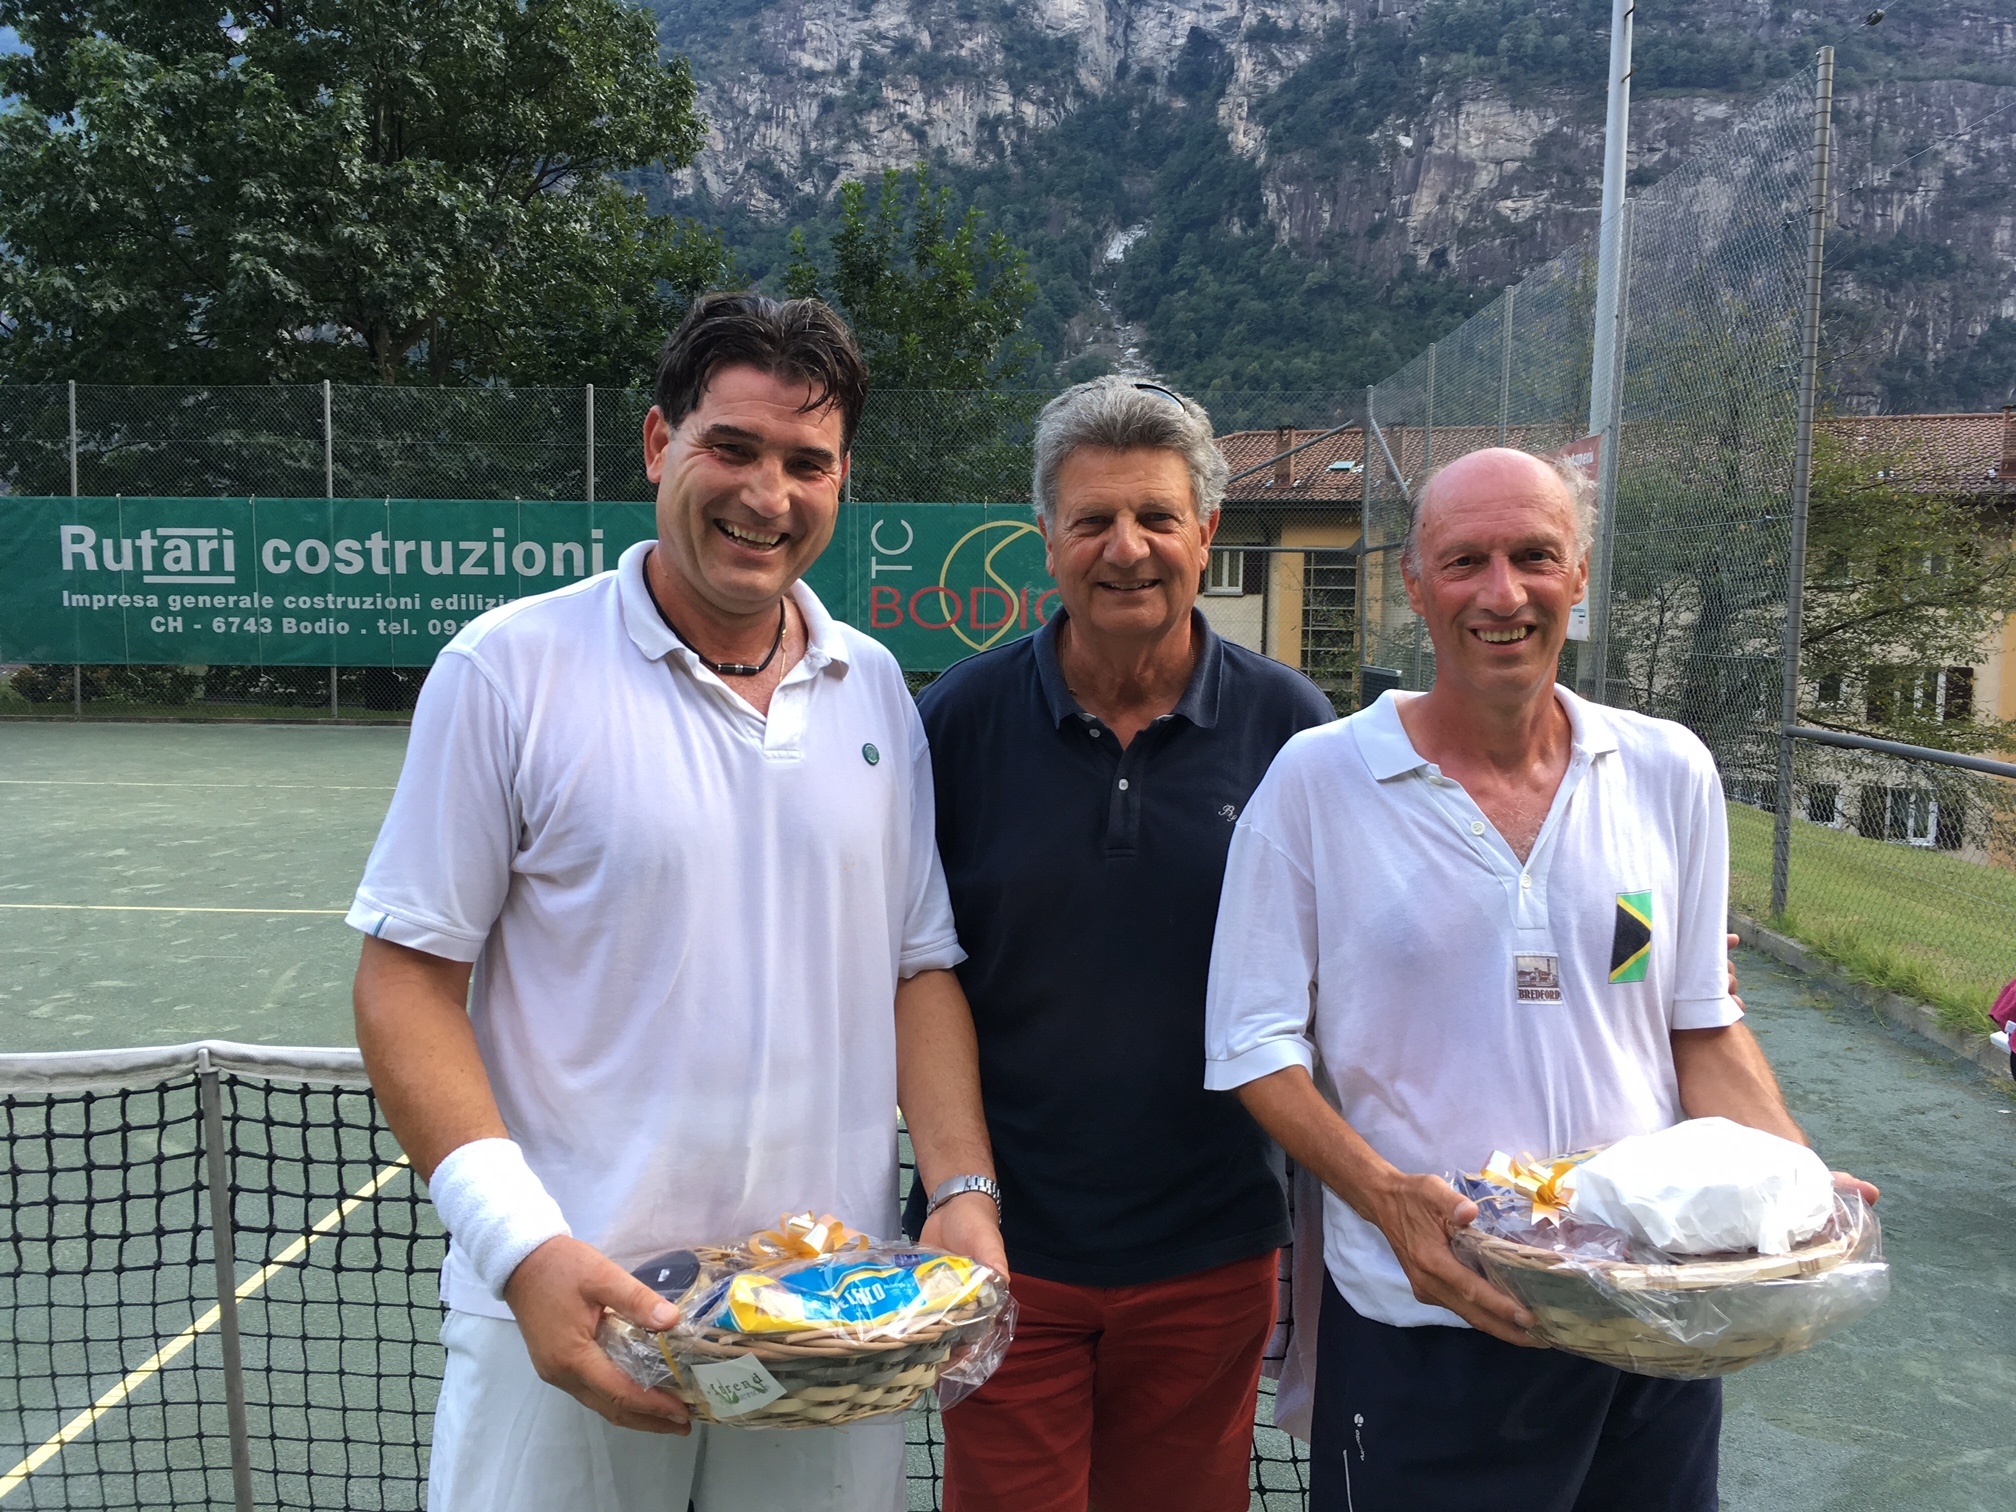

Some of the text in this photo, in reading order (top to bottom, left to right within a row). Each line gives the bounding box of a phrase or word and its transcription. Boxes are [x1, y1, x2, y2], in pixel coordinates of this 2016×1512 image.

[261, 527, 604, 577] costruzioni
[870, 519, 914, 580] TC
[62, 590, 517, 611] Impresa generale costruzioni edilizi
[150, 616, 184, 633] CH
[212, 617, 273, 635] 6743
[282, 617, 350, 635] Bodio
[377, 618, 418, 636] tel.
[1518, 989, 1561, 1000] BREDFORD
